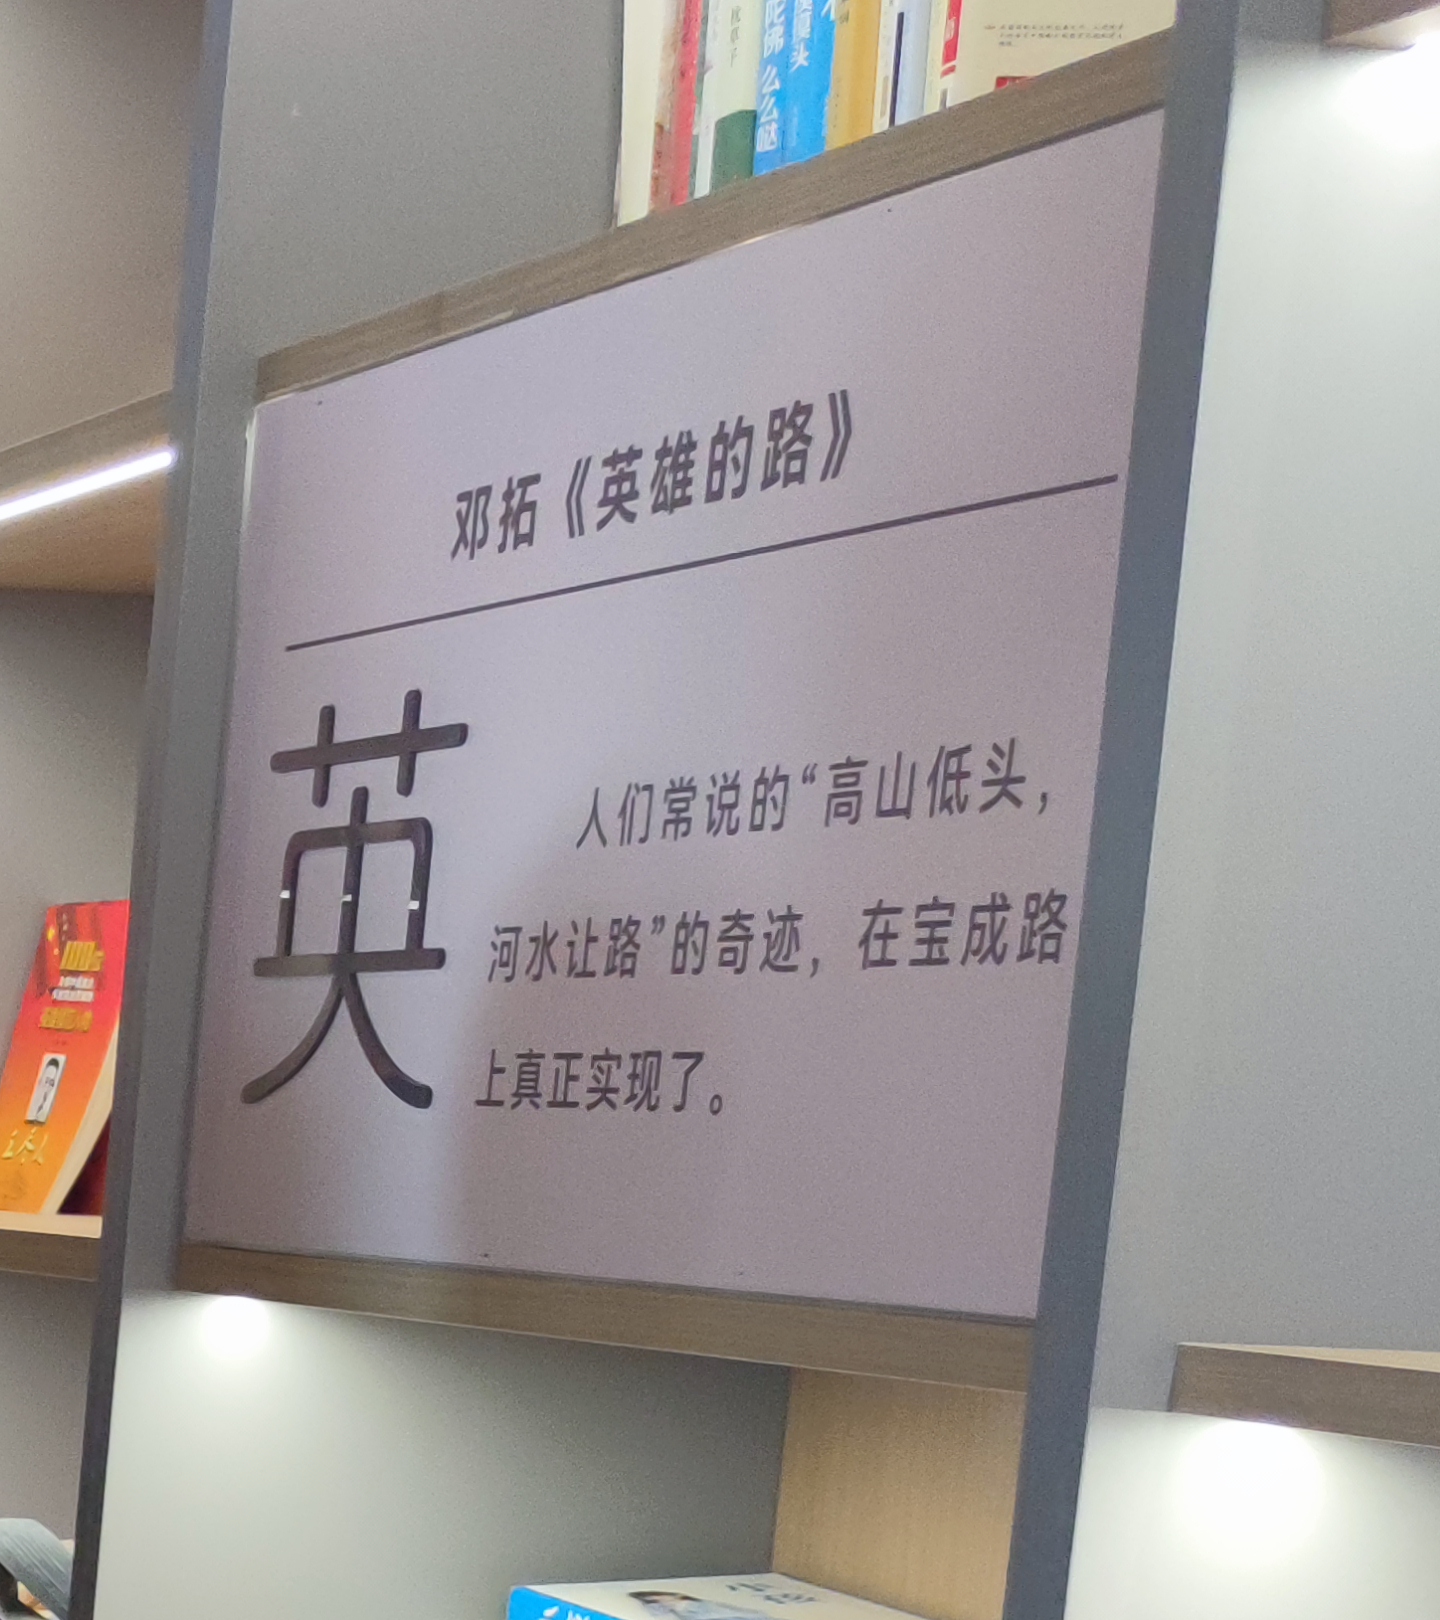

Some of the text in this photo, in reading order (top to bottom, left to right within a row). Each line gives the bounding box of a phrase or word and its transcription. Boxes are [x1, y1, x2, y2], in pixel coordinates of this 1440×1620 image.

[451, 390, 853, 561] 邓拓《英雄的路》
[575, 736, 1050, 849] 人们常说的“高山低头，
[241, 689, 469, 1109] 英
[487, 888, 1070, 984] 河水让路”的奇迹，在宝成路
[473, 1047, 727, 1116] 上真正实现了。
